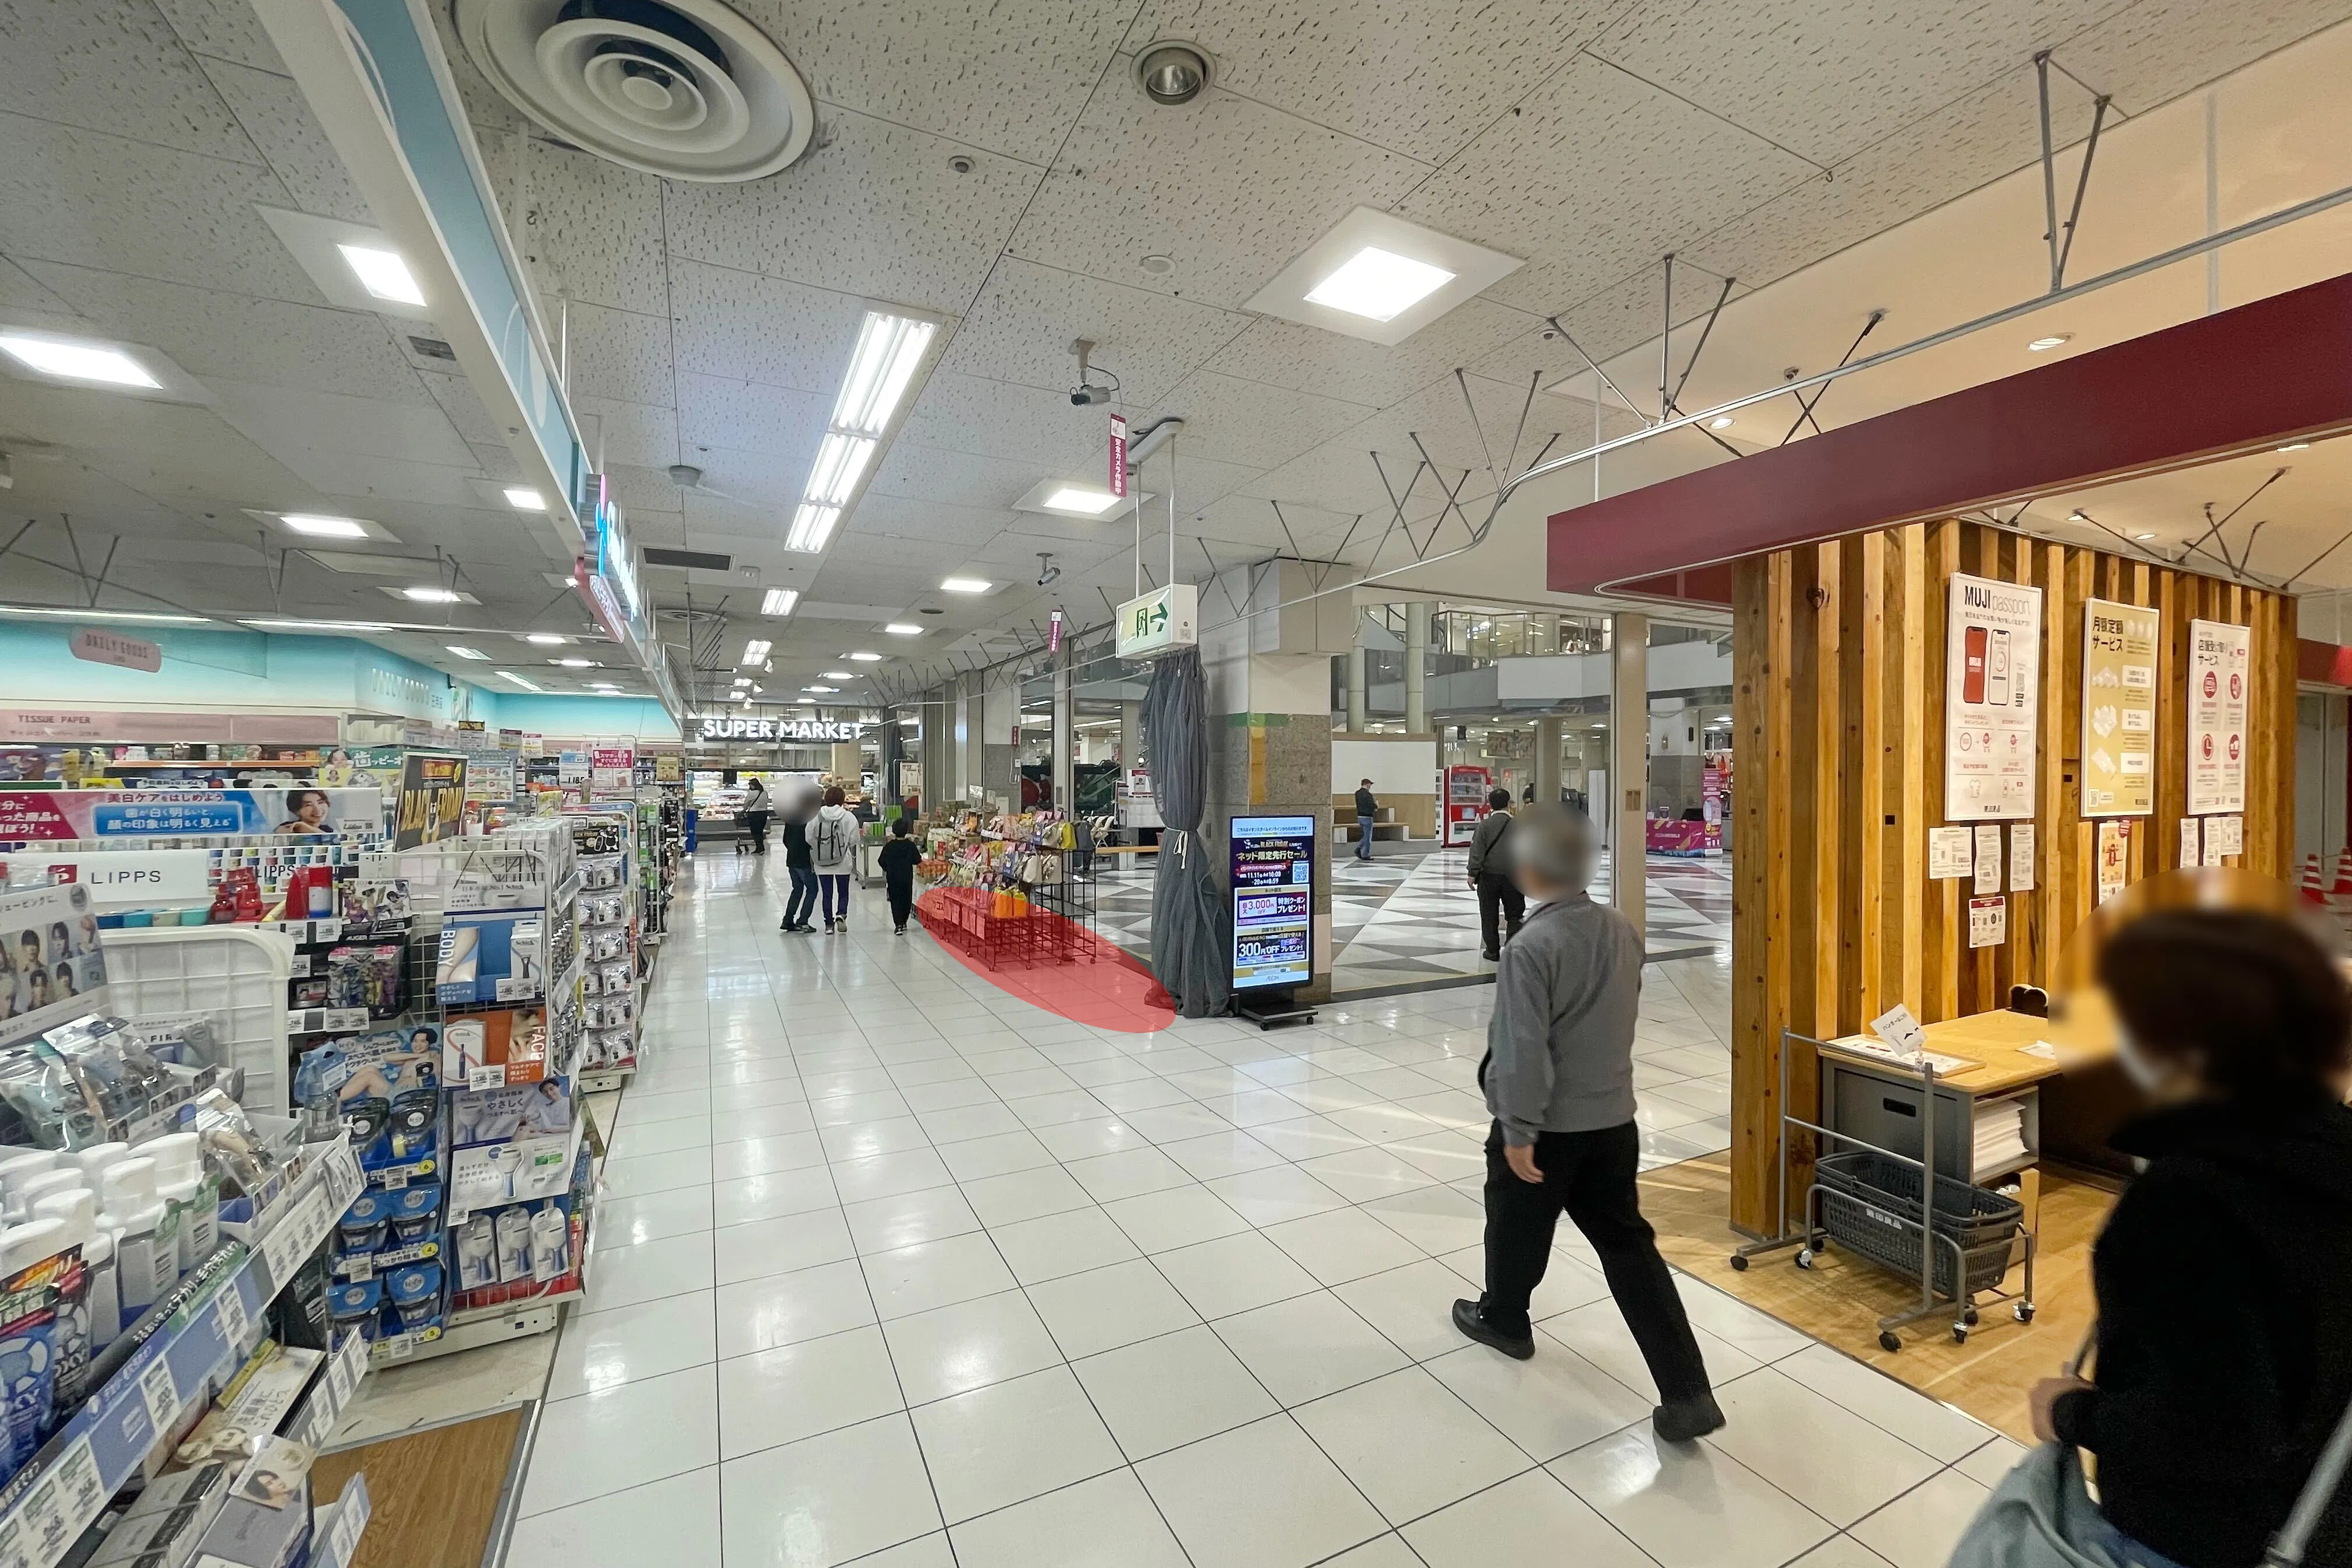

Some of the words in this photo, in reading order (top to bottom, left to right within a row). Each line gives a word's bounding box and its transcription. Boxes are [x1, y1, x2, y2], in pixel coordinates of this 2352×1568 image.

[1965, 585, 1990, 609] MUJI
[1992, 595, 2031, 617] passport
[86, 634, 116, 652] DAILY
[2092, 635, 2123, 652] サービス
[19, 715, 55, 723] TISSUE
[61, 716, 91, 724] PAPER
[704, 719, 774, 738] SUPER
[779, 720, 864, 740] MARKET
[91, 870, 161, 884] LIPPS
[1278, 904, 1306, 914] プレゼント!
[438, 930, 457, 967] BODY
[487, 1098, 523, 1110] やさしく
